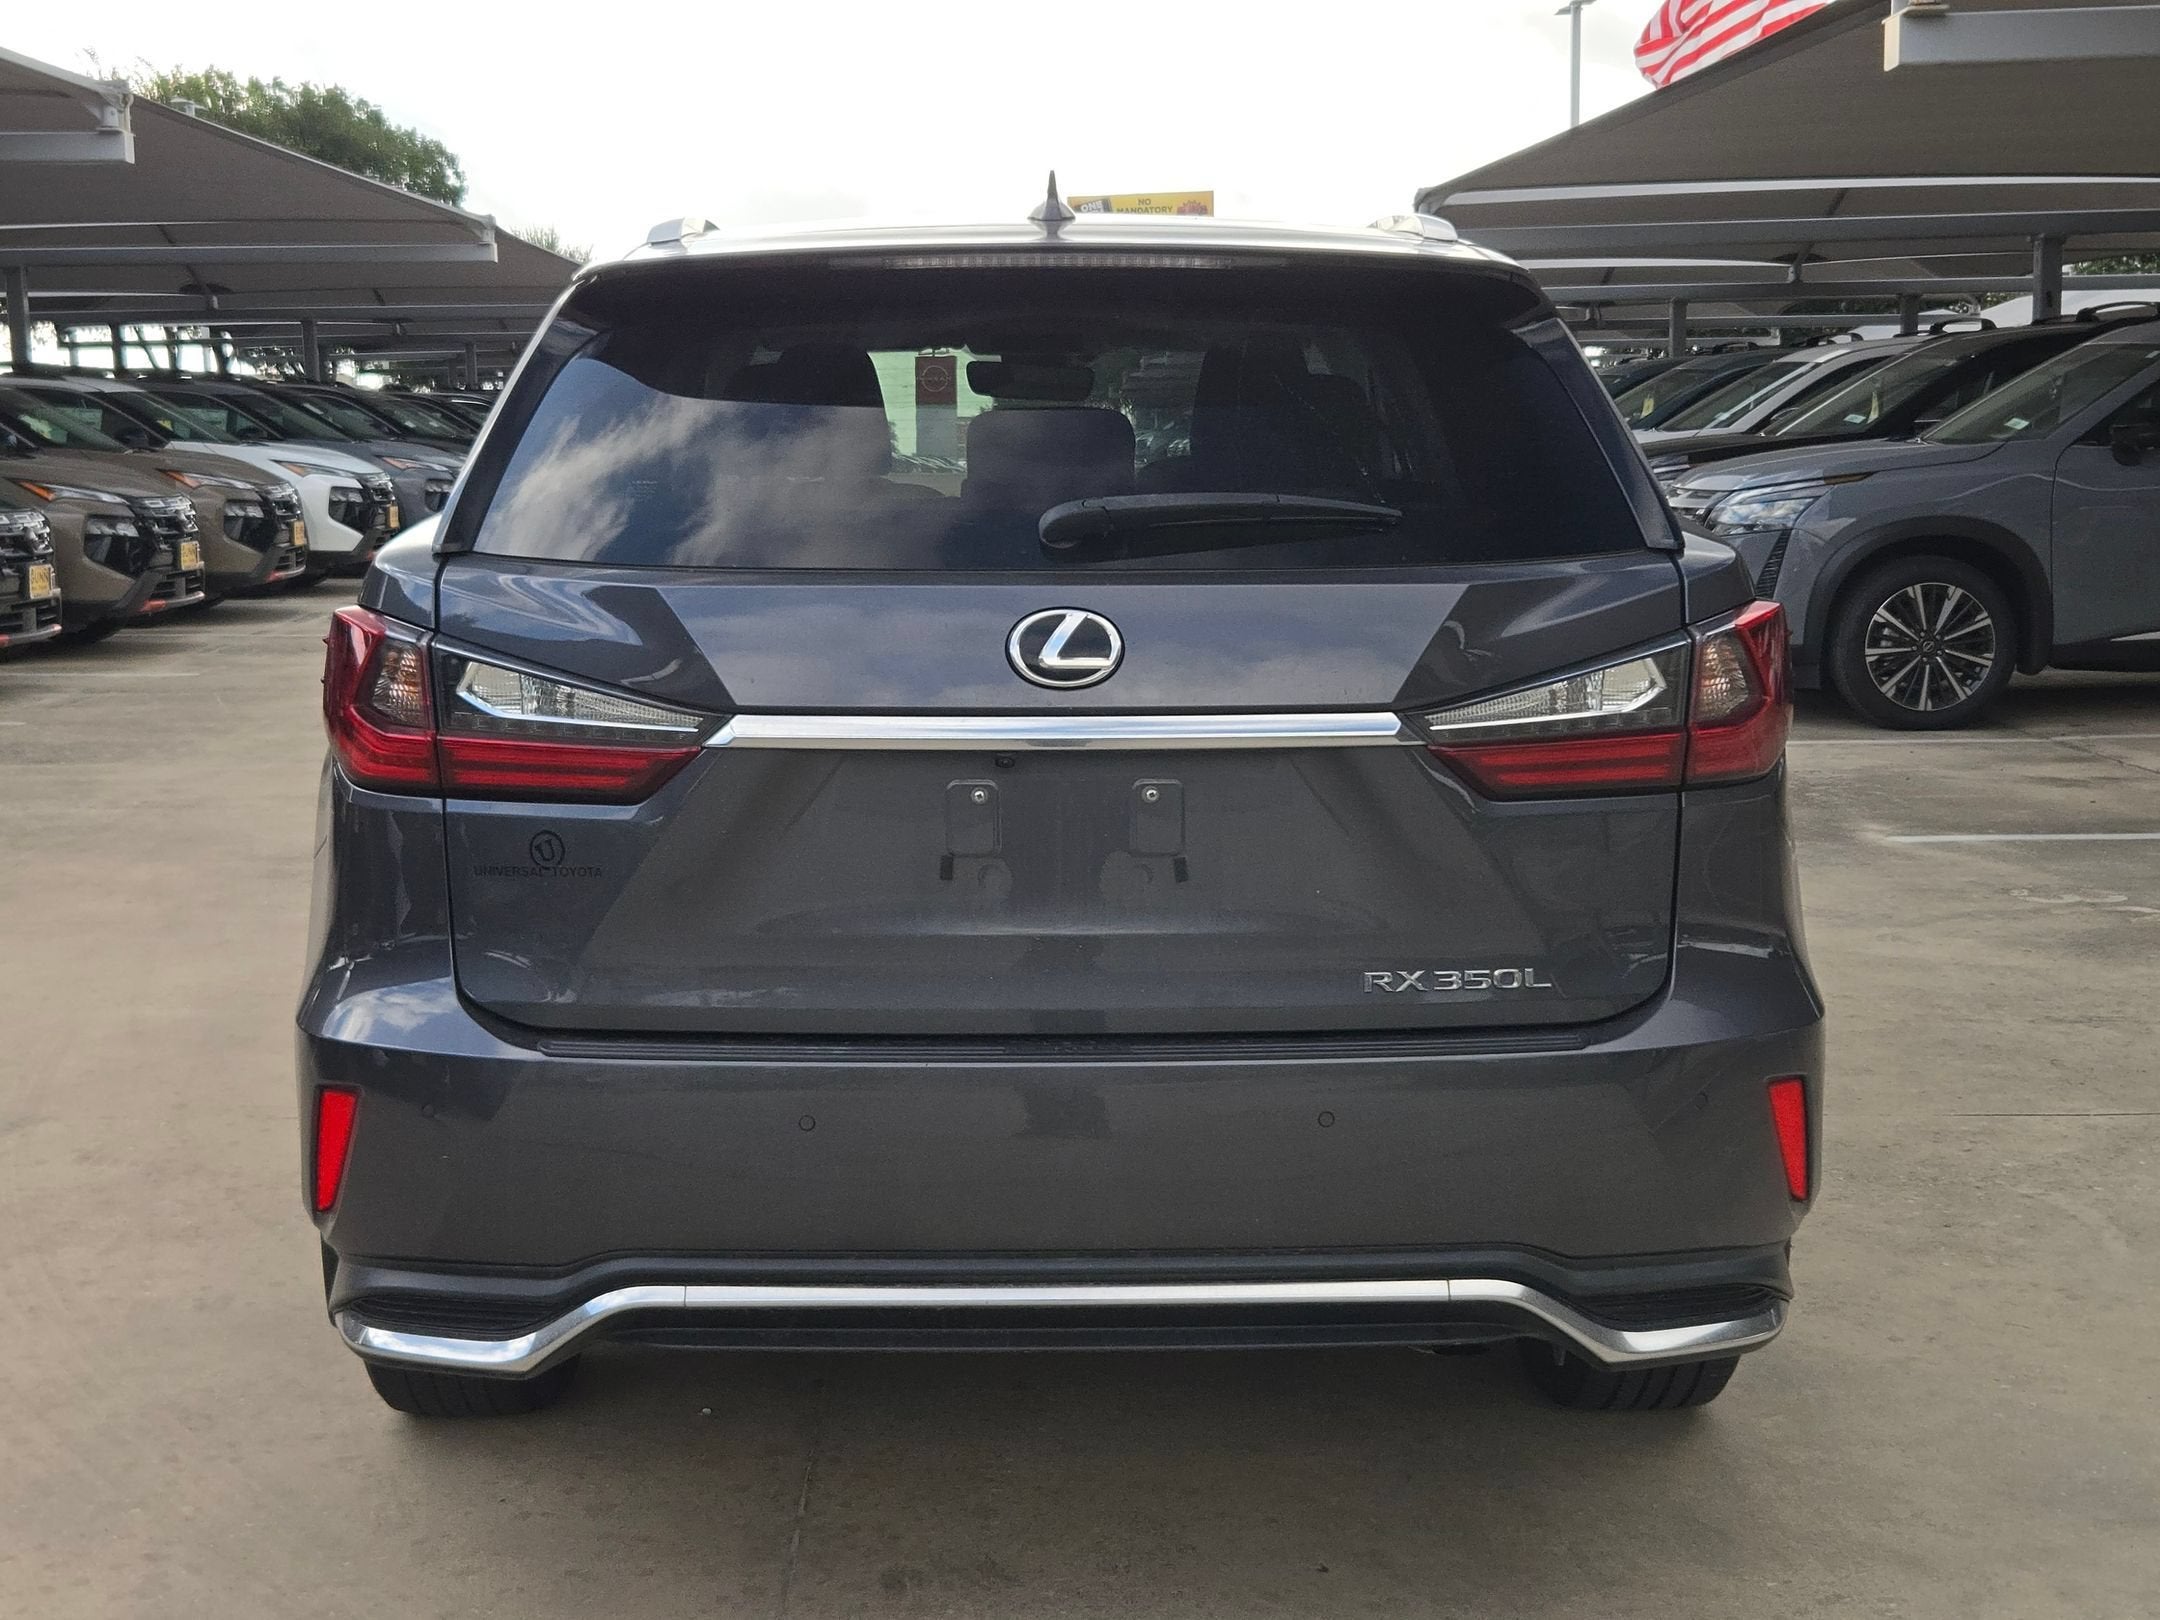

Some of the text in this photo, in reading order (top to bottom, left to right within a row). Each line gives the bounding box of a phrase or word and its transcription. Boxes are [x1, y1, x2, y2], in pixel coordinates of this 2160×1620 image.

[1080, 200, 1104, 212] ONE
[1138, 198, 1152, 206] NO
[1116, 206, 1173, 214] MANDATORY
[473, 865, 602, 878] UNIVERSAL TOYOTA
[1363, 967, 1552, 993] RX 350L
